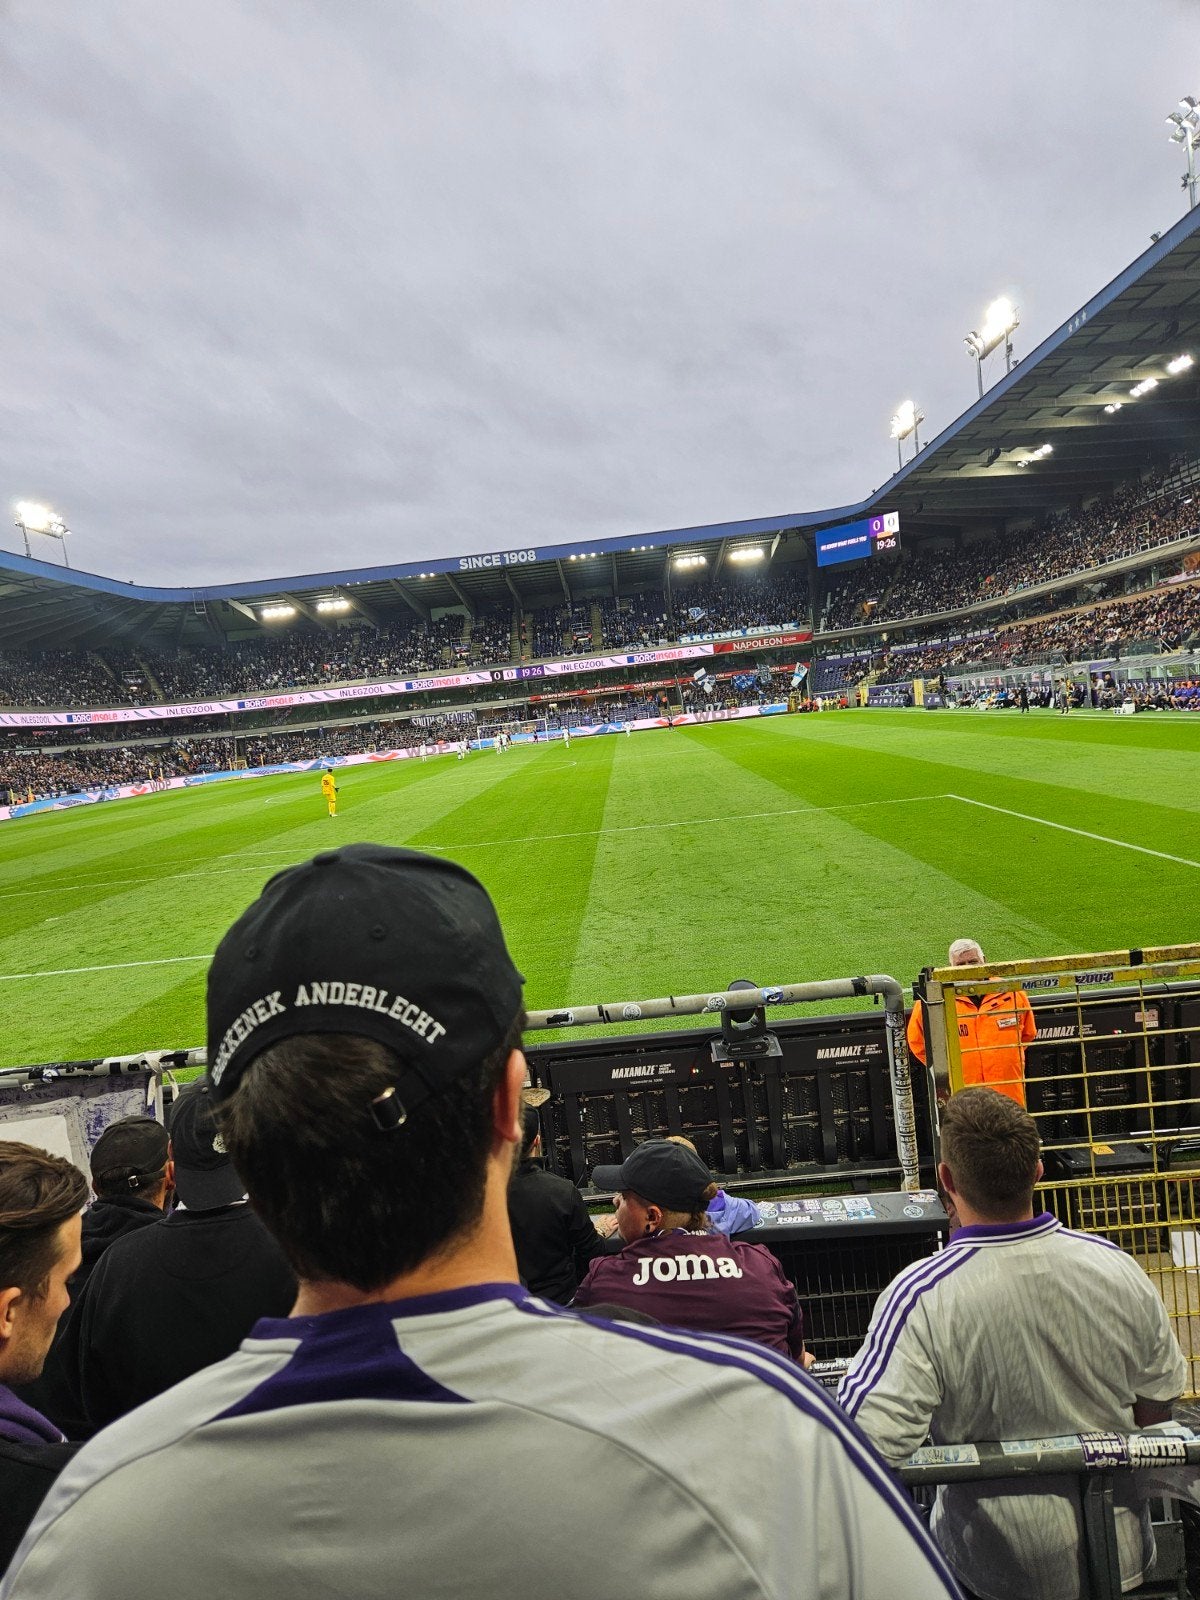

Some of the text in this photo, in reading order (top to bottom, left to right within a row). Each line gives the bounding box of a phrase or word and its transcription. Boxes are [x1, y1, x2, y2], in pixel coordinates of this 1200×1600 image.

[873, 520, 881, 531] 0
[877, 538, 896, 550] 19:26
[459, 550, 537, 570] SINCE 1908
[681, 622, 798, 644] RACING GENK
[733, 637, 783, 650] NAPOLEON
[560, 659, 606, 671] INLEGZOOL
[494, 672, 501, 681] 0
[339, 686, 385, 697] INLEGZOOL
[165, 704, 215, 716] INLEGZOOL
[694, 708, 740, 722] WDP
[411, 711, 475, 727] SOUTH LEADERS
[405, 743, 451, 758] WDP
[149, 779, 172, 793] WDP
[295, 981, 446, 1045] ANDERLECHT
[1034, 1026, 1075, 1039] AXAMAZE
[817, 1046, 862, 1060] MAXAMAZE
[611, 1064, 655, 1079] MAXAMAZE
